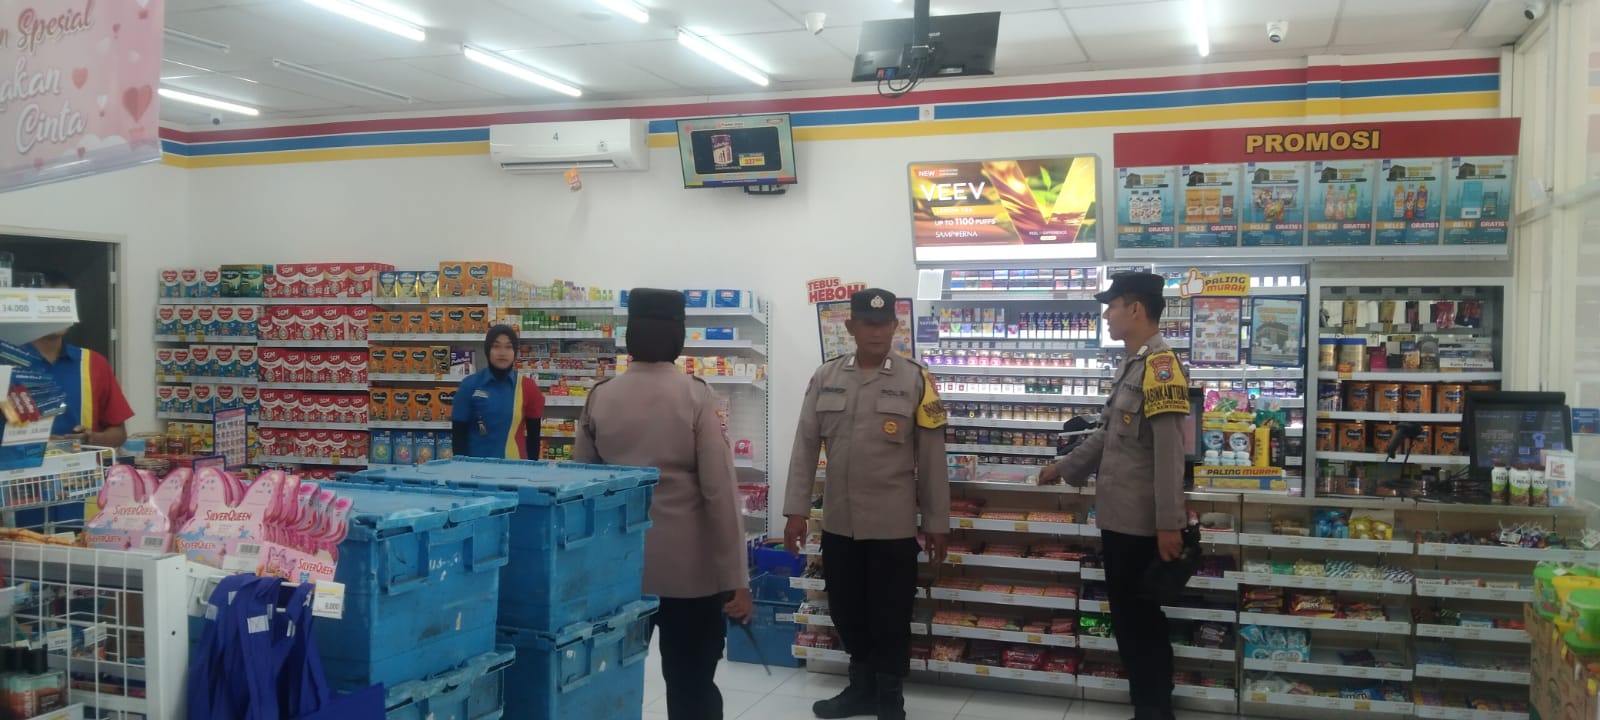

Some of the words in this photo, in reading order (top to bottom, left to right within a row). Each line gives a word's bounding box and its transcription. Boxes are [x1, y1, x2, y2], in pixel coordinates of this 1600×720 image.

[17, 0, 95, 53] Spesial
[16, 100, 86, 155] Cinta
[1245, 130, 1381, 154] PROMOSI
[920, 181, 985, 201] VEEV
[1480, 220, 1504, 228] GRATIS
[808, 279, 840, 290] TEBUS
[1205, 276, 1246, 286] PALING
[1207, 284, 1246, 292] MURAH
[205, 509, 252, 522] SILVERQUEEN
[297, 558, 333, 575] SILVERQUEEN
